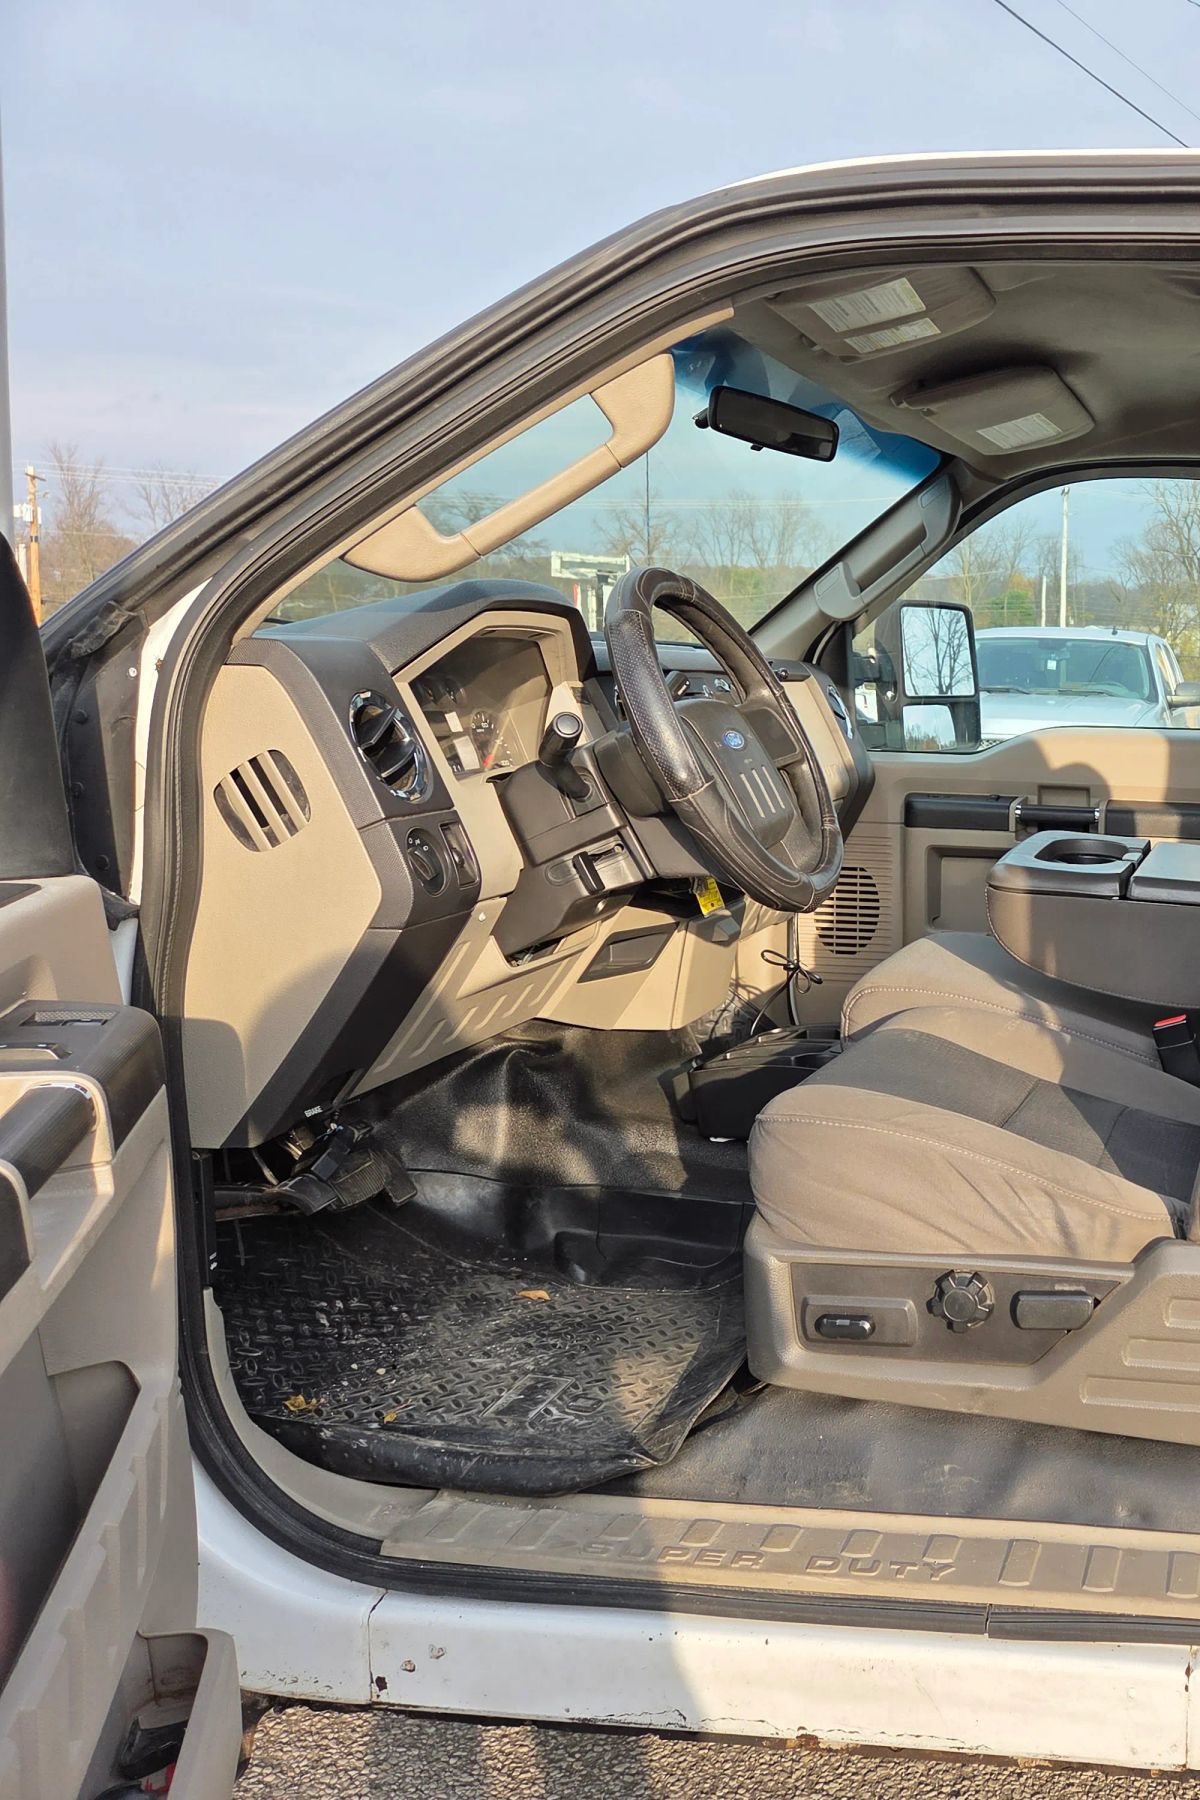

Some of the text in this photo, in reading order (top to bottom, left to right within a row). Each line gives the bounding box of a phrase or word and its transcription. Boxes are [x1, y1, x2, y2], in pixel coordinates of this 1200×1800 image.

[303, 1105, 323, 1118] BRAKE
[582, 1543, 956, 1582] SUPER DUTY
